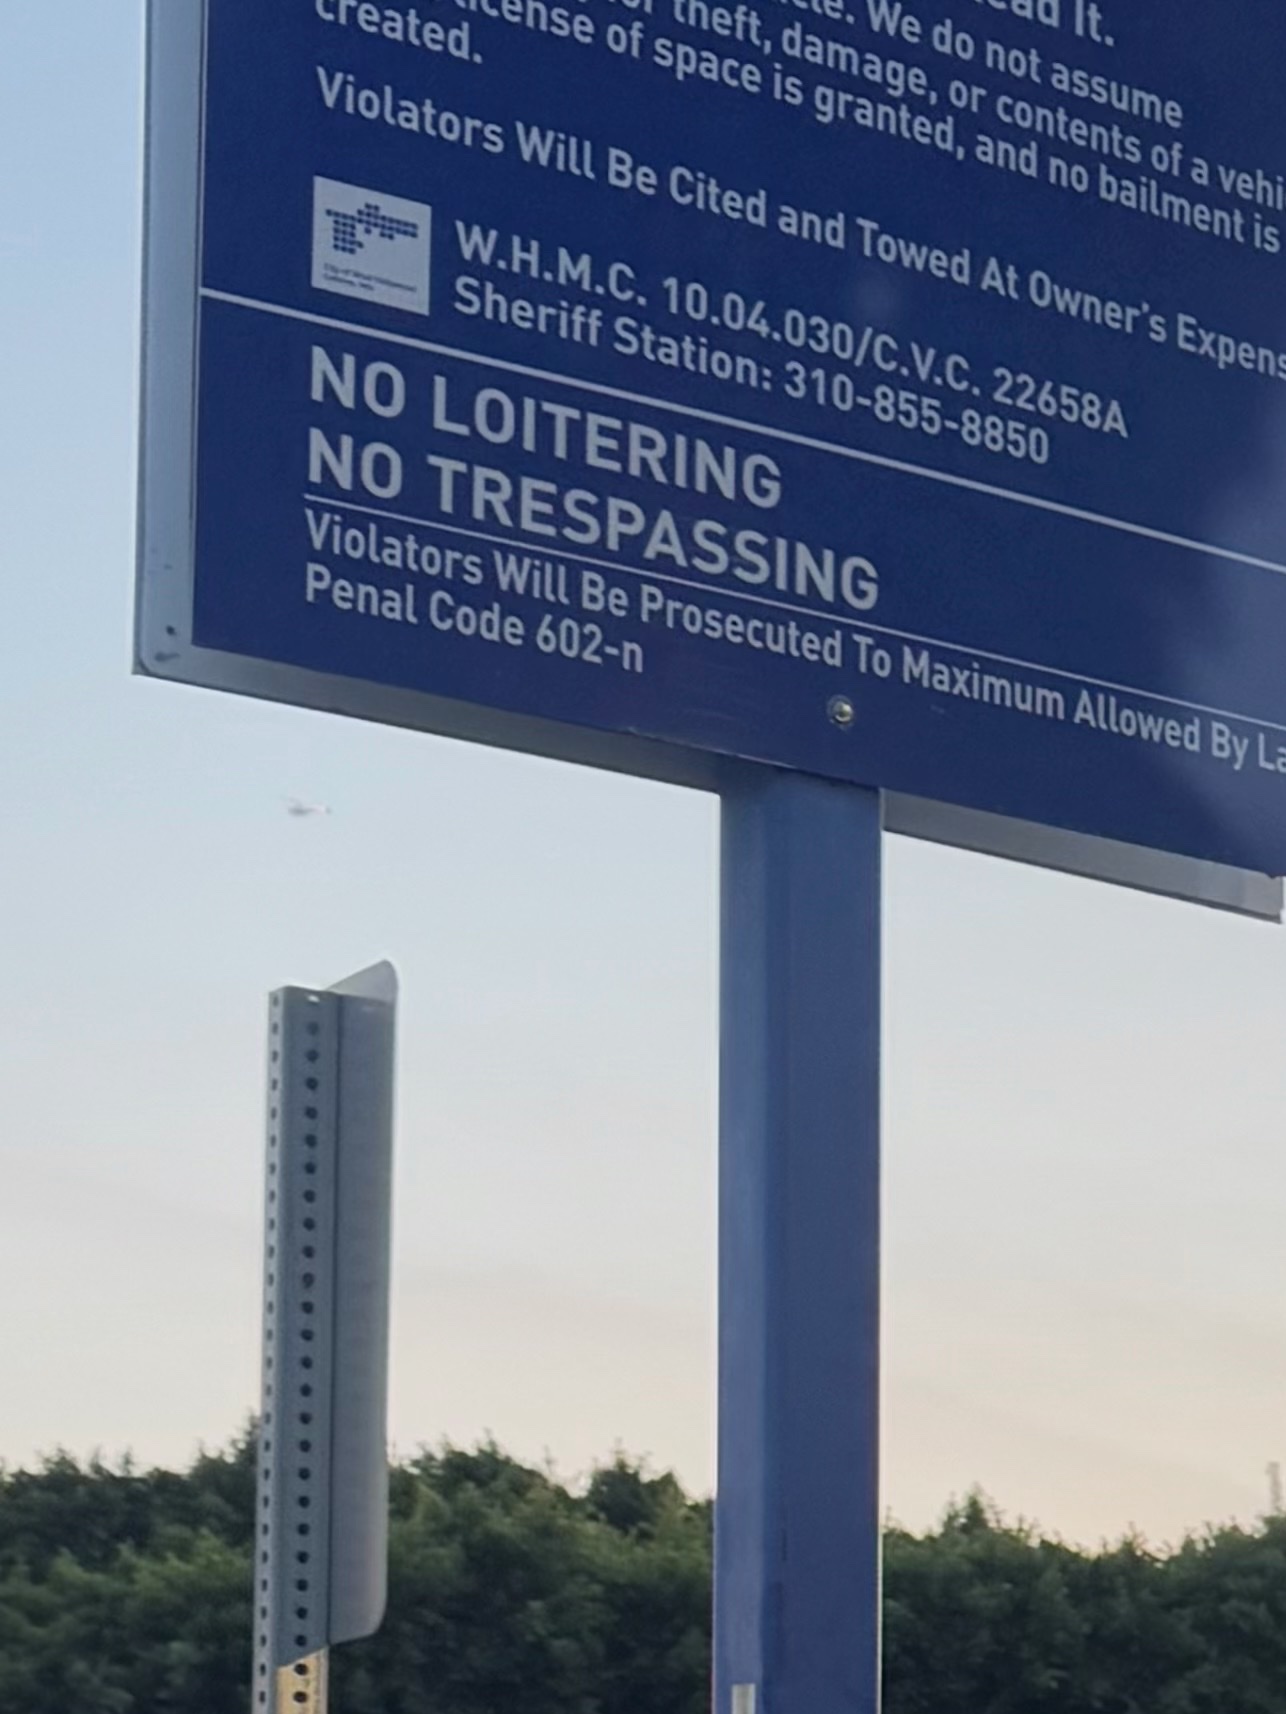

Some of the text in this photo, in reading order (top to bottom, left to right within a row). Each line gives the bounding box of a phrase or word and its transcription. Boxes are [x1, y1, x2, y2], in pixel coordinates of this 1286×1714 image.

[315, 0, 483, 64] created.
[673, 0, 772, 55] theft,
[781, 21, 938, 106] damage,
[948, 79, 988, 113] or
[996, 95, 1142, 164] contents
[1150, 141, 1183, 177] of
[1190, 157, 1209, 186] a
[866, 0, 922, 44] We
[932, 18, 975, 61] do
[985, 40, 1042, 84] not
[1050, 62, 1183, 129] assume
[974, 0, 1114, 47] ad It.
[316, 65, 505, 154] Violators
[515, 120, 596, 180] Will
[607, 146, 658, 196] Be
[669, 165, 767, 228] Cited
[777, 205, 845, 249] and
[855, 217, 971, 286] Towed
[980, 256, 1019, 300] At
[1029, 269, 1167, 343] Owner's
[454, 0, 1281, 254] cense of space is granted, and no bailment is
[453, 275, 603, 347] Sheriff
[613, 316, 772, 391] Station:
[784, 360, 1049, 464] 310-855-8850
[455, 219, 1129, 438] W.H.M.C. 10.04.030/C.V.C. 22658A
[308, 426, 879, 611] NO TRESPASSING
[310, 345, 781, 509] NO LOITERING
[304, 507, 484, 585] Violators
[492, 549, 570, 605] Will
[581, 570, 629, 617] Be
[640, 583, 842, 668] Prosecuted
[851, 633, 892, 678] To
[902, 644, 1065, 720] Maximum
[1073, 688, 1201, 752] Allowed
[1211, 721, 1249, 771] By
[305, 561, 643, 673] Penal Code 602-n
